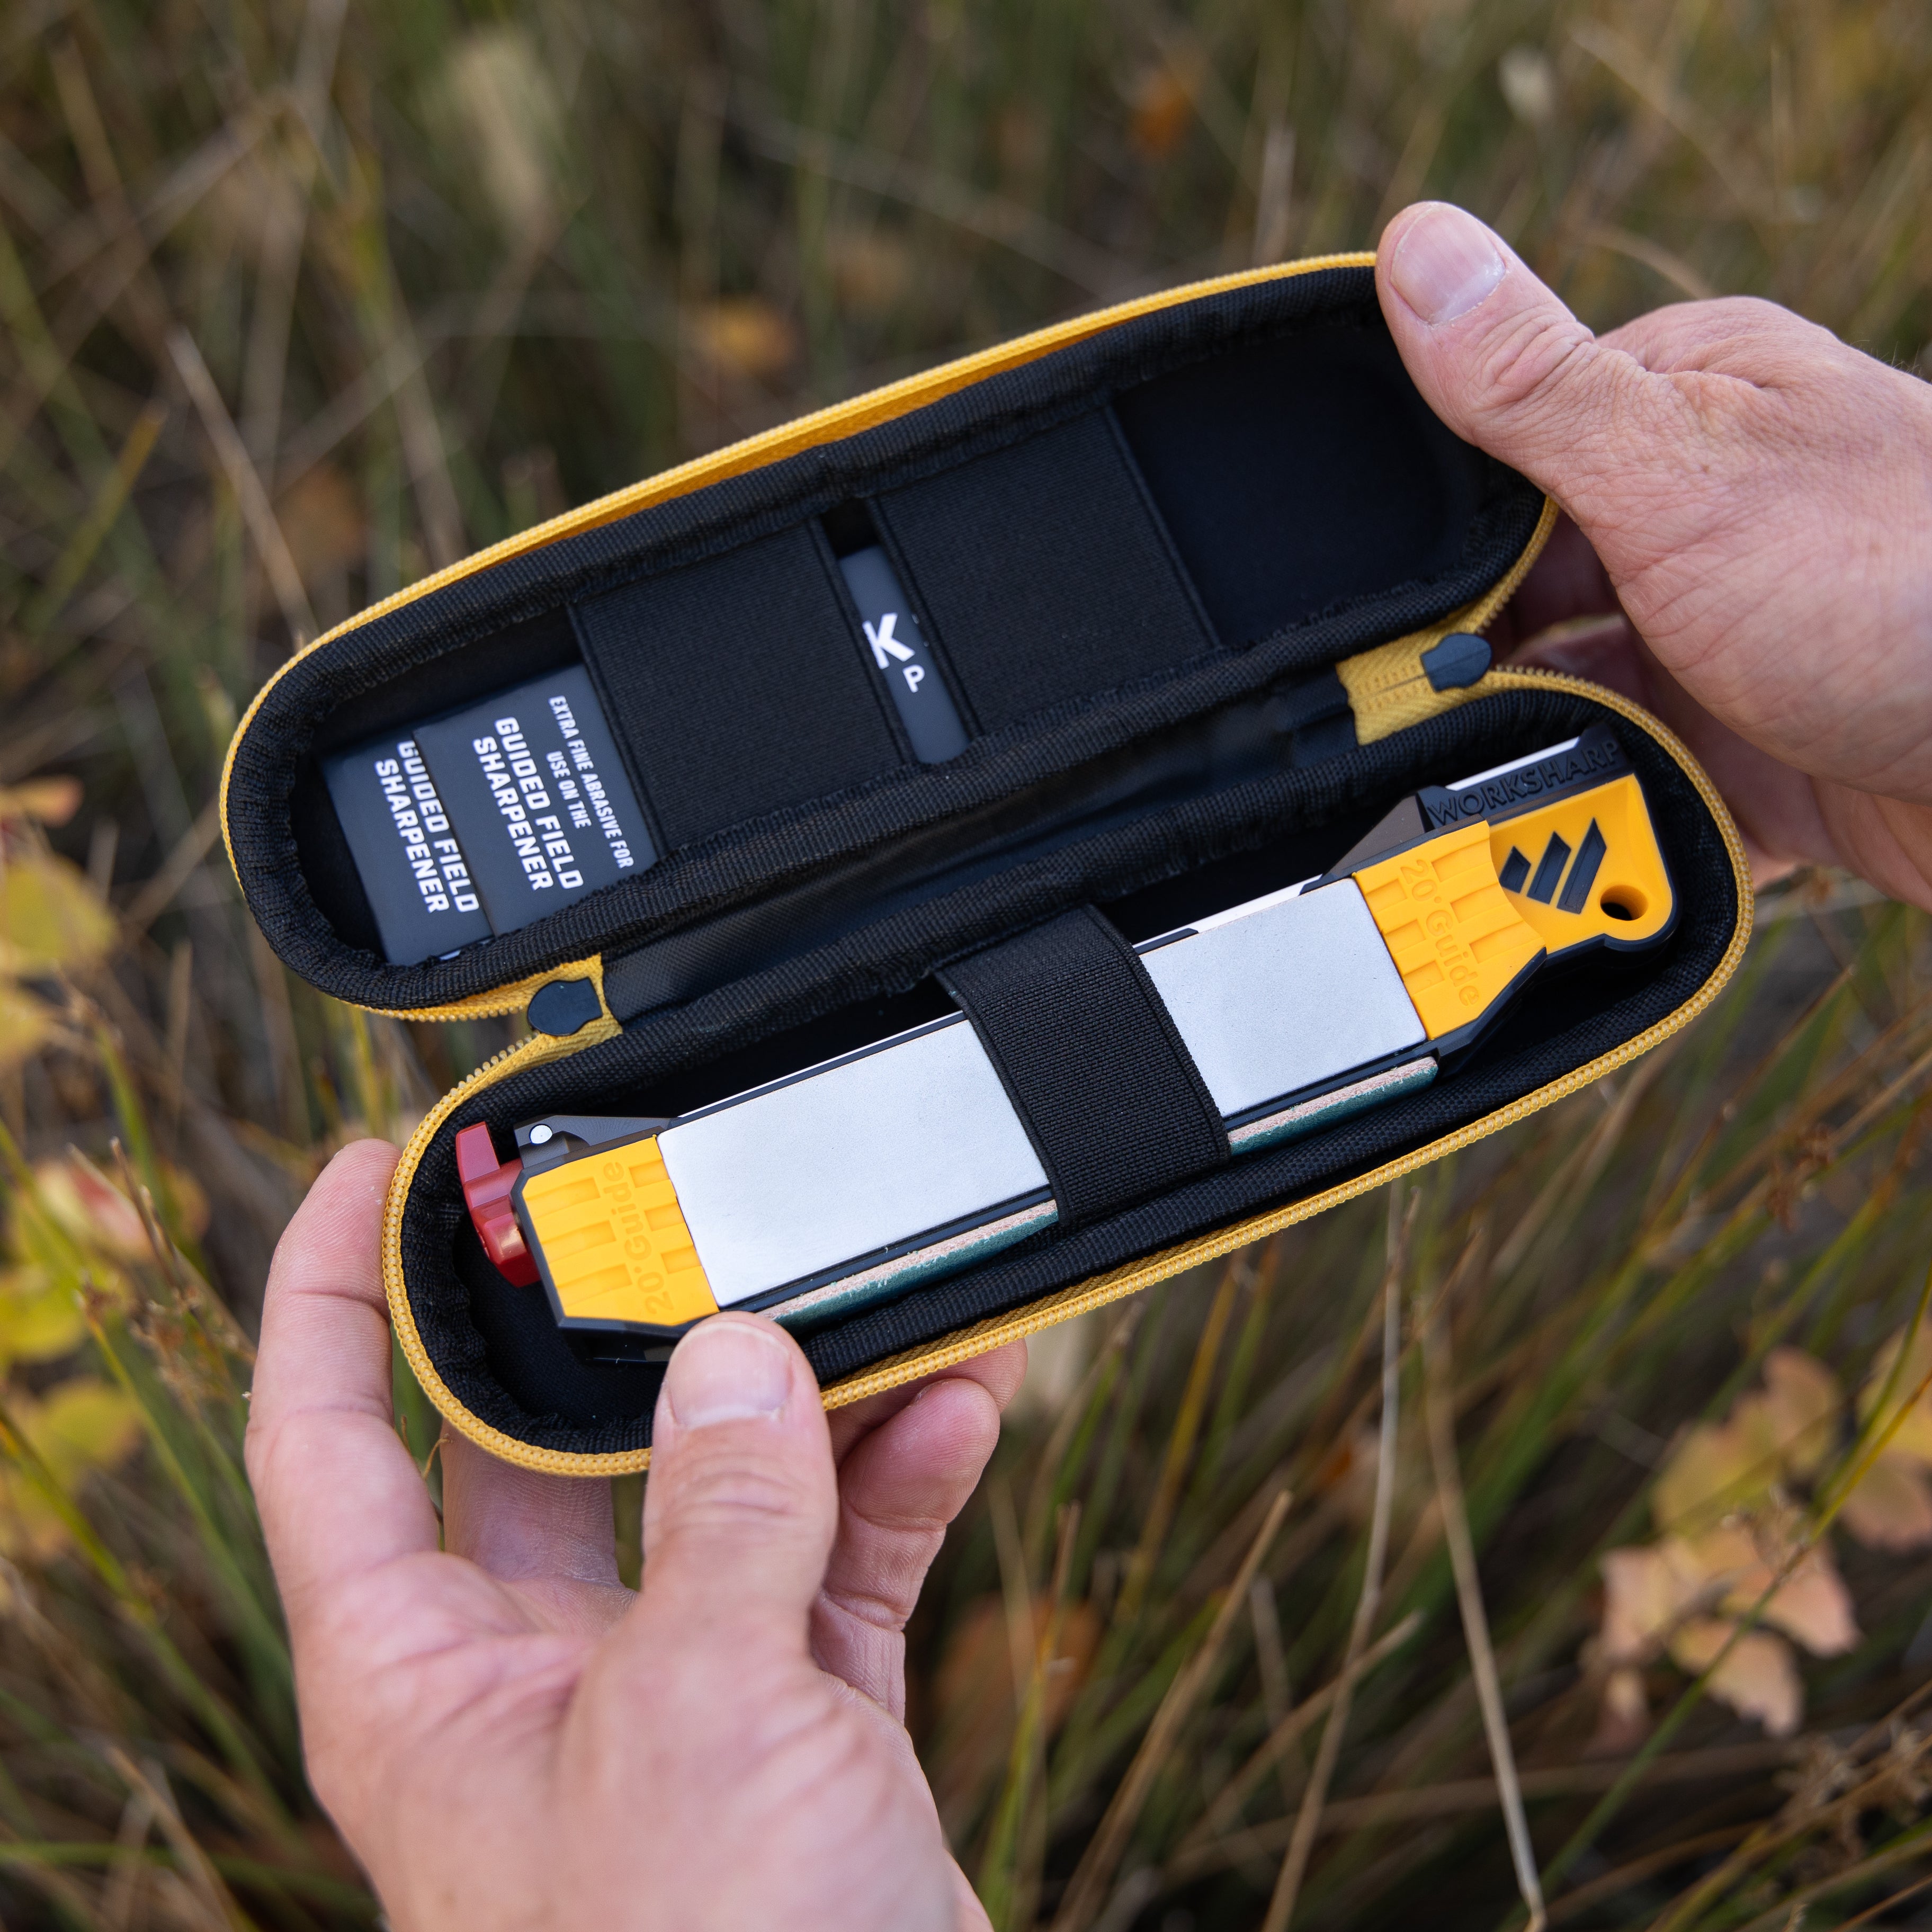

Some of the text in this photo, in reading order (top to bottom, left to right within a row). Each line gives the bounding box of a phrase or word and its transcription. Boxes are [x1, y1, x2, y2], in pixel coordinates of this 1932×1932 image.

[902, 664, 925, 693] P
[375, 758, 450, 913] SHARPENER
[397, 740, 479, 913] GUIDED FIELD
[472, 736, 554, 891] SHARPENER
[495, 717, 584, 889] GUIDED FIELD
[546, 750, 592, 829] USE ON THE
[548, 695, 634, 869] EXTRA FINE ABRASIVE FOR
[1426, 909, 1480, 1007] Guide
[603, 1161, 652, 1261] Guide
